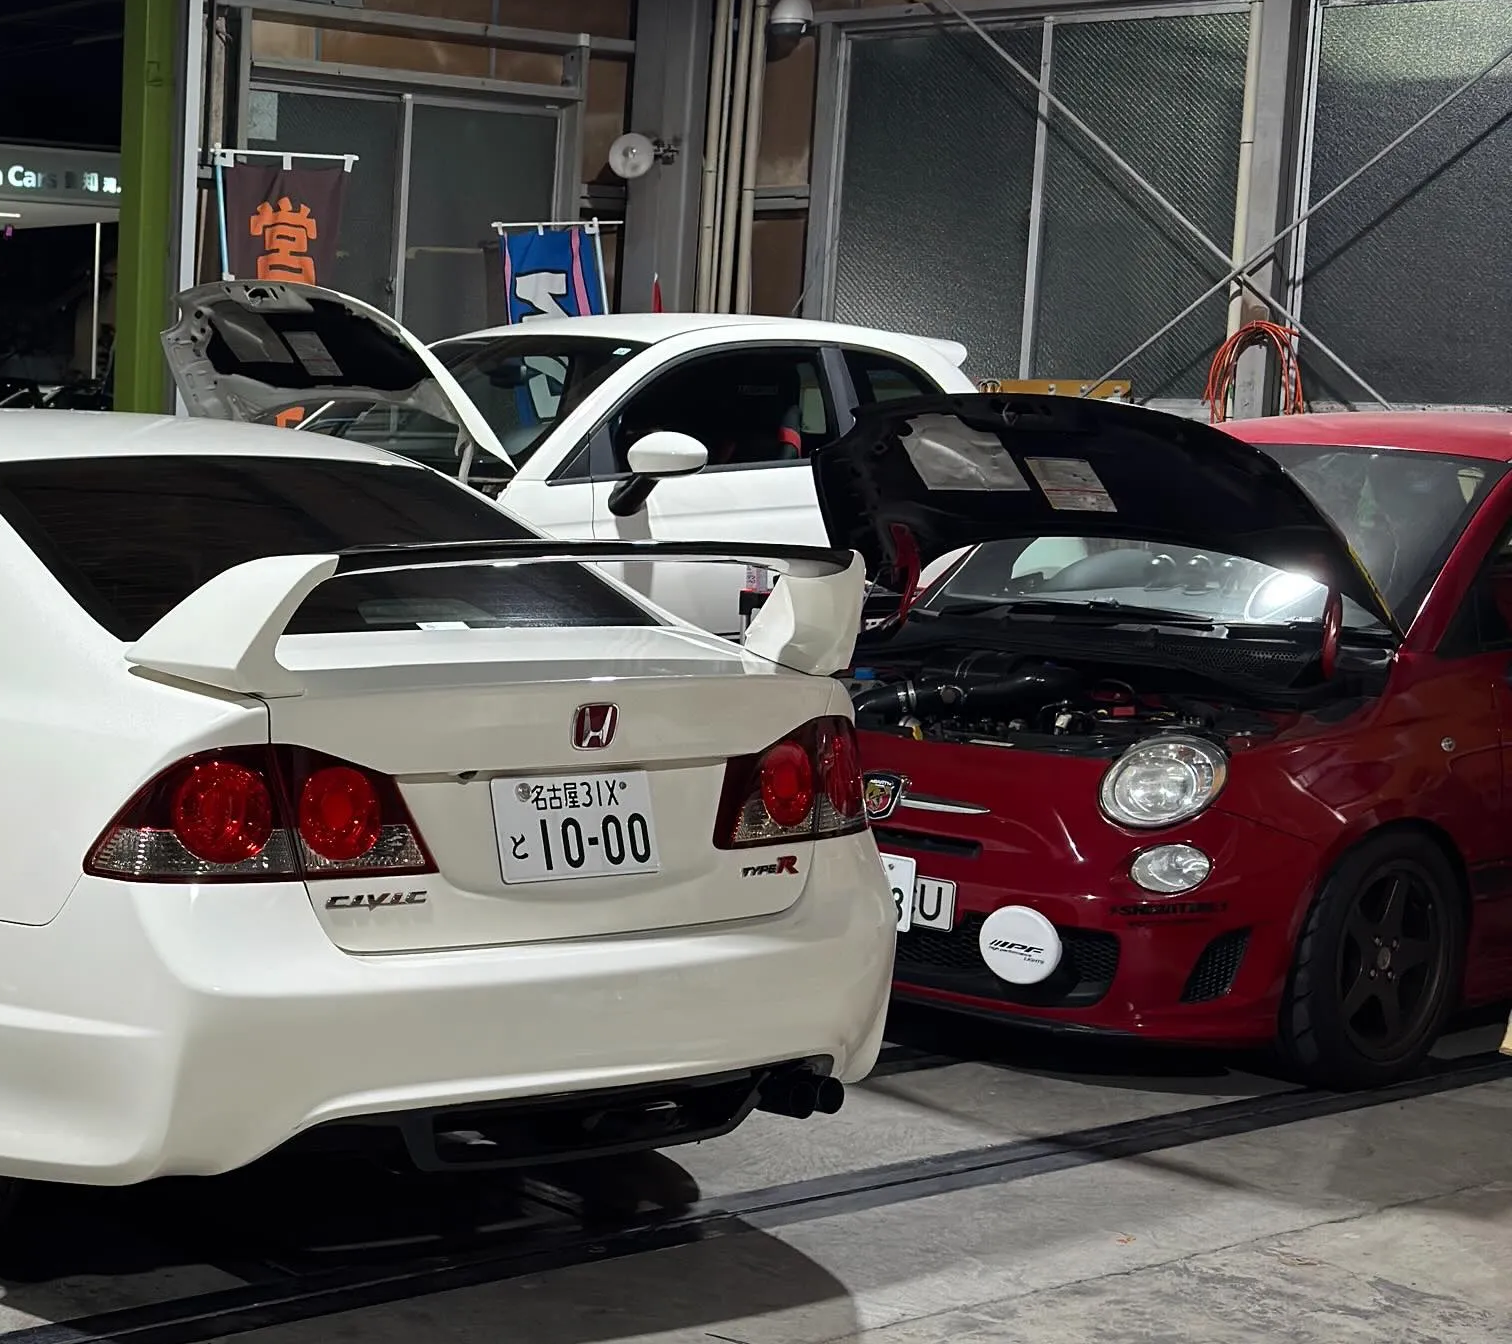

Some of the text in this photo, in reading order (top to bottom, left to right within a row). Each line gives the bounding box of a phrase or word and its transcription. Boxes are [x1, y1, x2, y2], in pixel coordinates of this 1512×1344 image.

[7, 165, 58, 189] Cars
[510, 812, 651, 871] と 10-00
[325, 890, 428, 912] CIVIC
[912, 884, 943, 921] U
